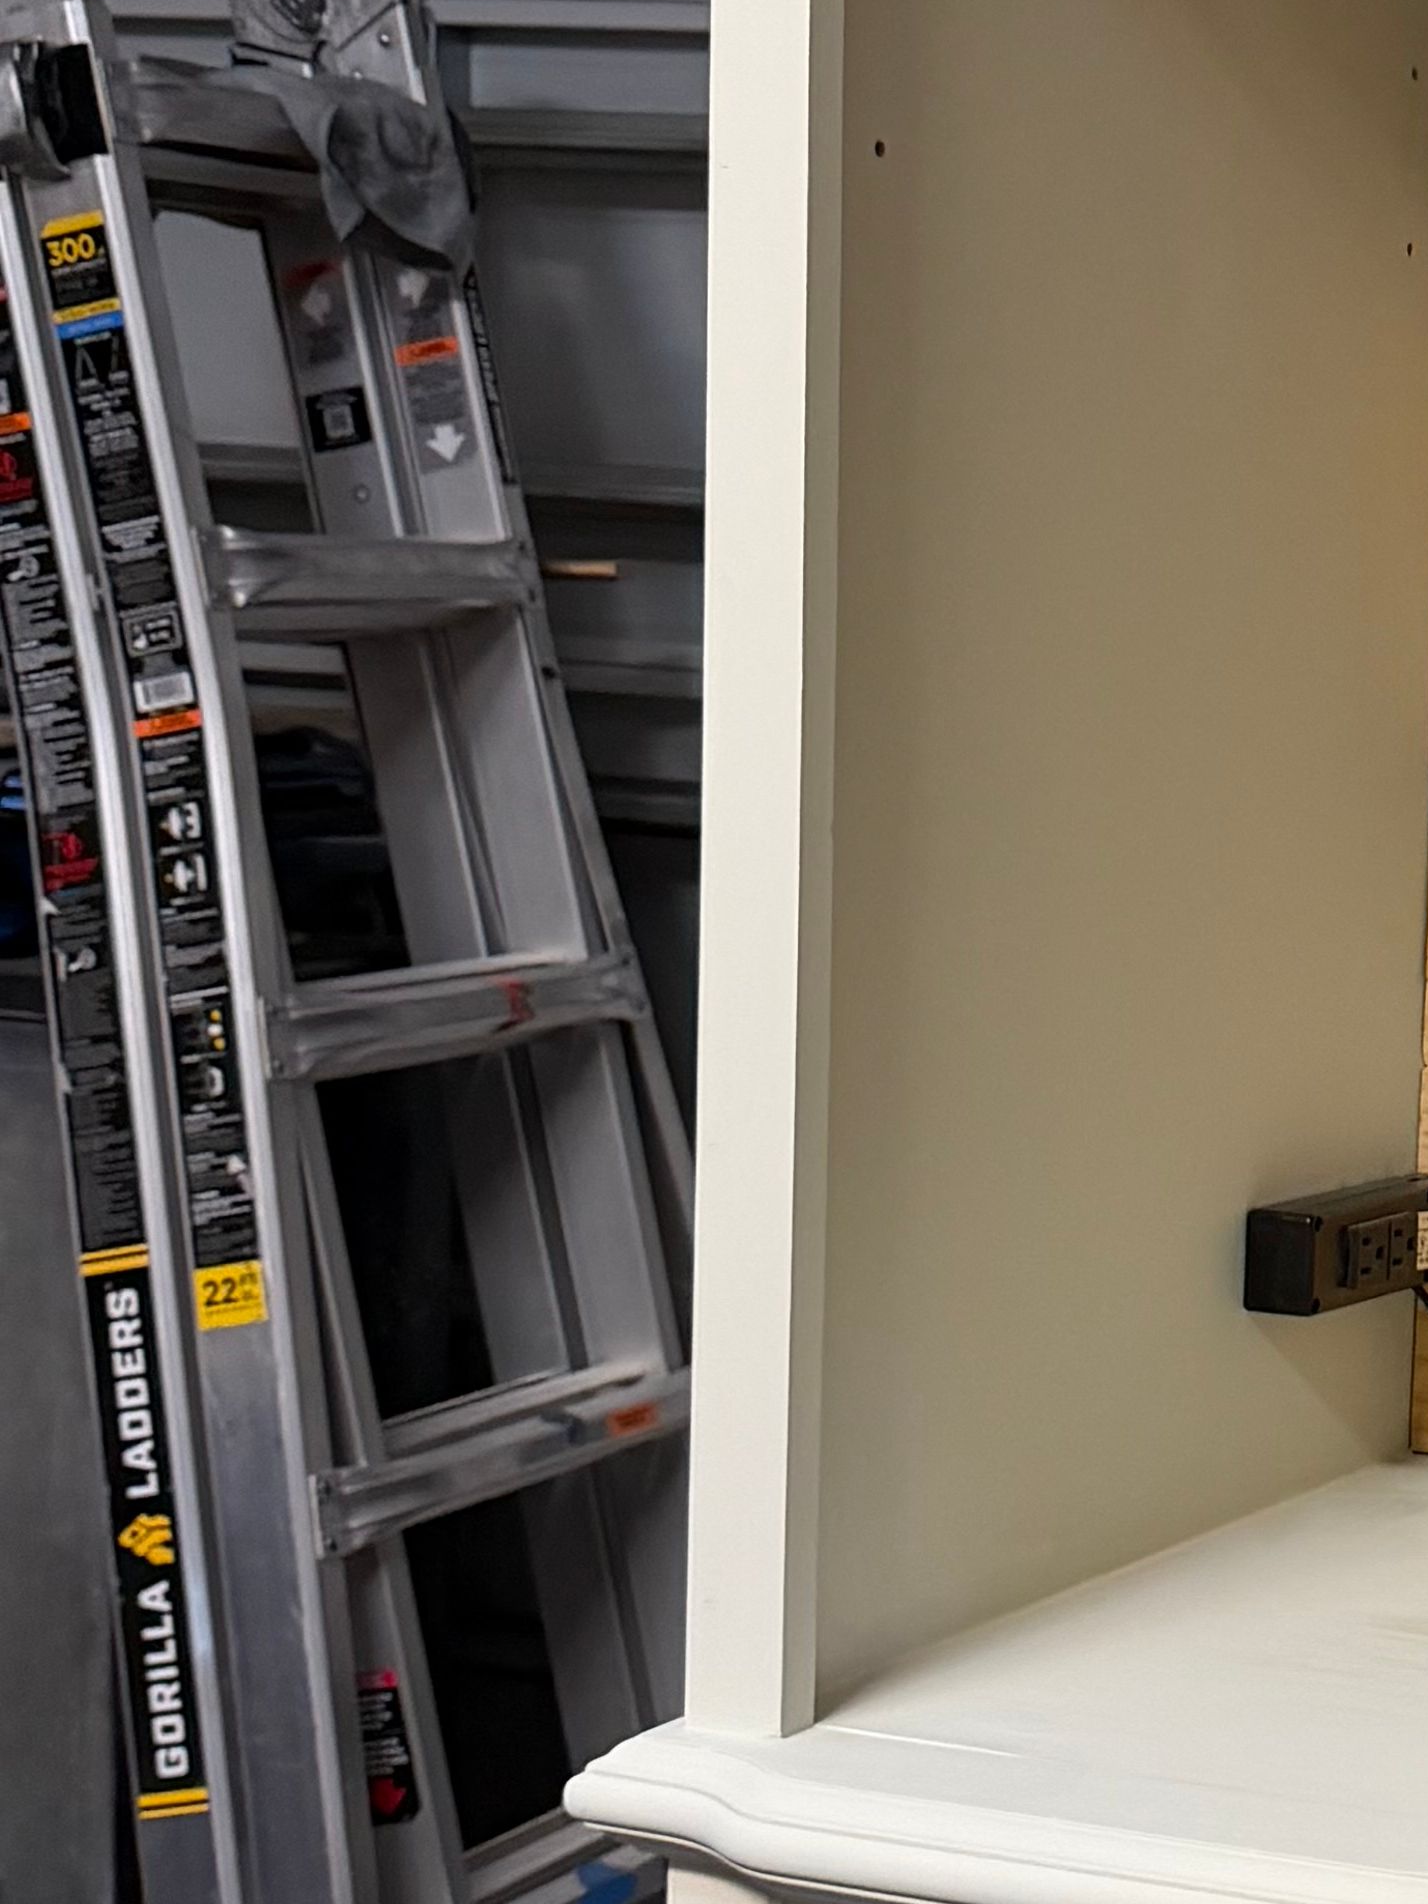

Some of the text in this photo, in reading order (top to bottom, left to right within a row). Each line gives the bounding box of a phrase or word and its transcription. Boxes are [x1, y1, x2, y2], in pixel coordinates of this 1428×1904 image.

[47, 233, 96, 267] 300
[203, 1277, 239, 1307] 22
[107, 1288, 189, 1780] GORILLA LADDERS
